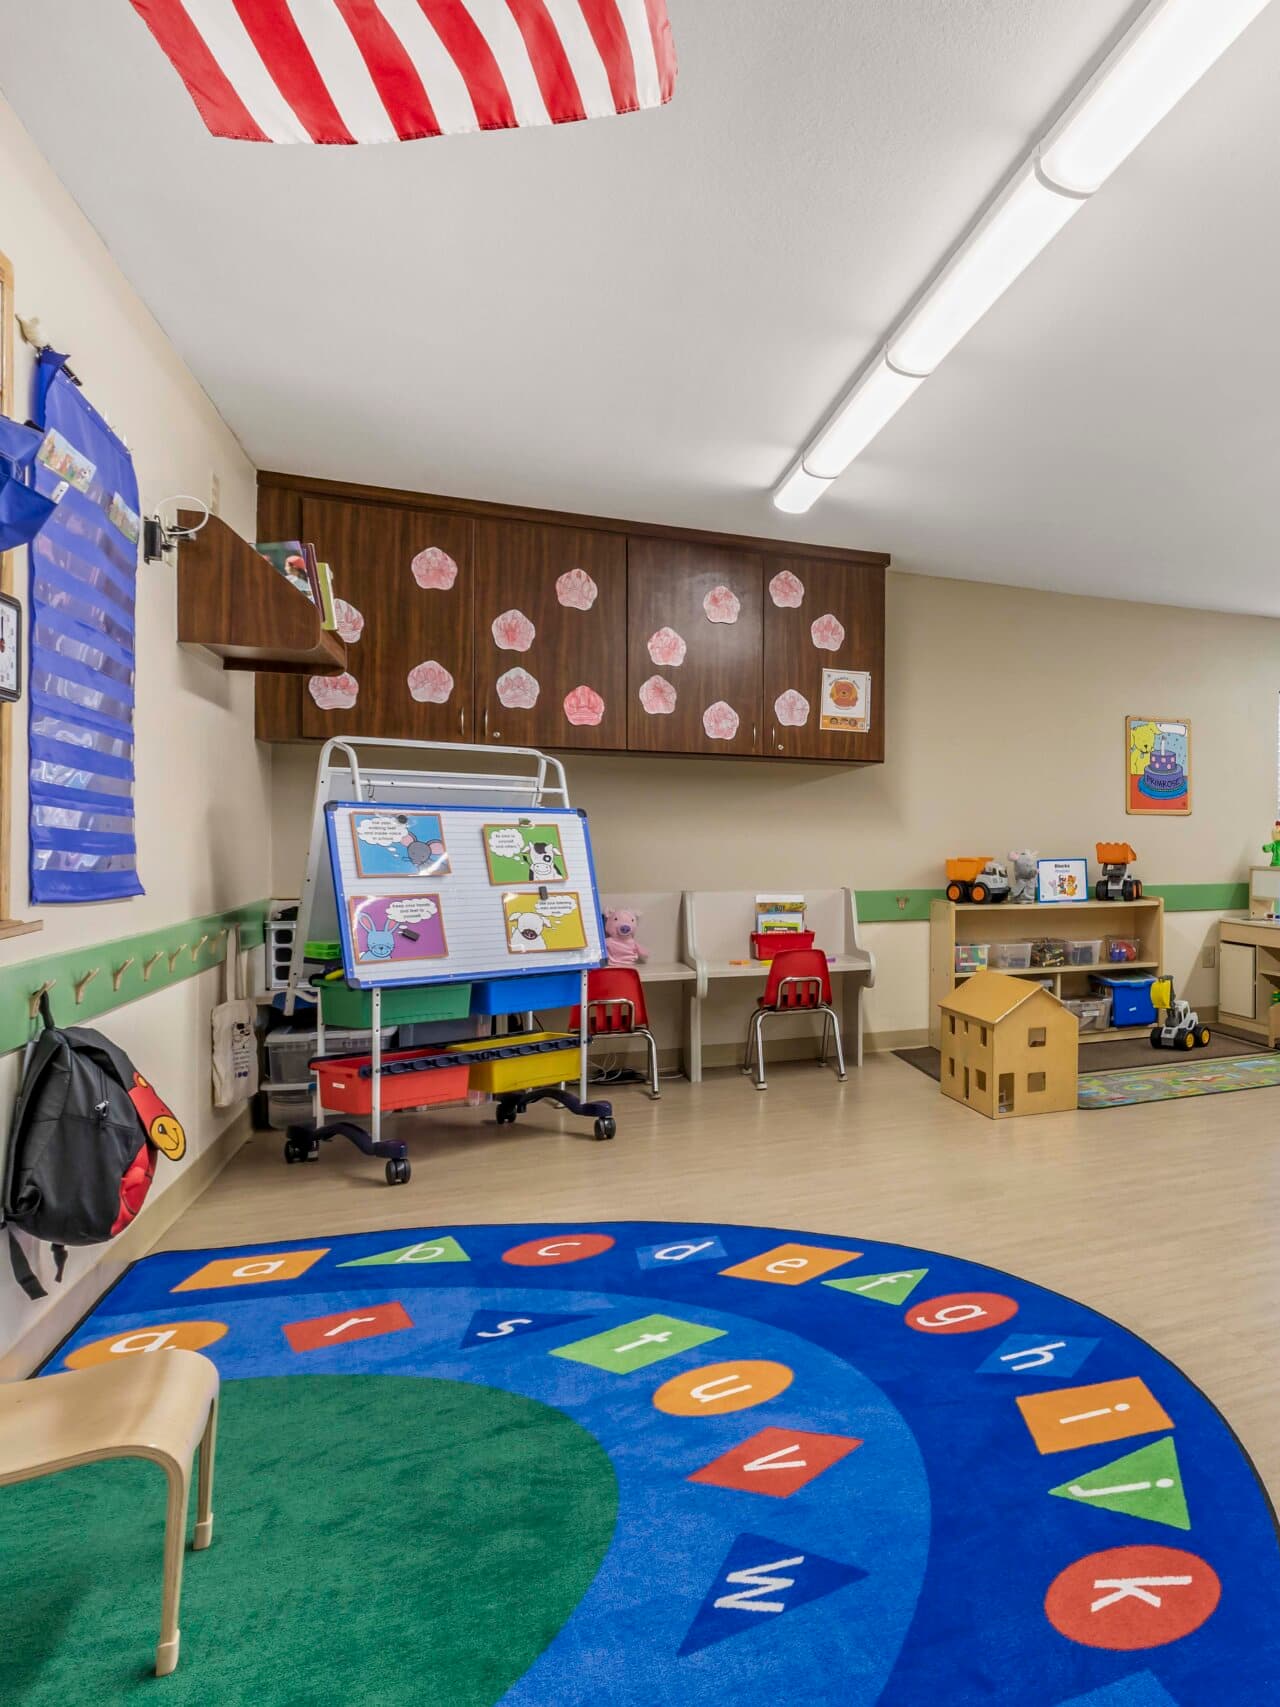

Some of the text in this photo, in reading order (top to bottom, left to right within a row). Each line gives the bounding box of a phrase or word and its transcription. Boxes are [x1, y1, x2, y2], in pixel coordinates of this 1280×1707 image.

[394, 1241, 445, 1264] b
[537, 1241, 582, 1258] c
[653, 1240, 715, 1262] d
[232, 1256, 282, 1280] a
[765, 1257, 809, 1276] e
[855, 1271, 914, 1294] f
[916, 1303, 987, 1327] g
[323, 1313, 376, 1338] r
[613, 1330, 673, 1354] t
[1000, 1342, 1066, 1371] h
[1059, 1402, 1131, 1424] i
[1067, 1476, 1175, 1498] j
